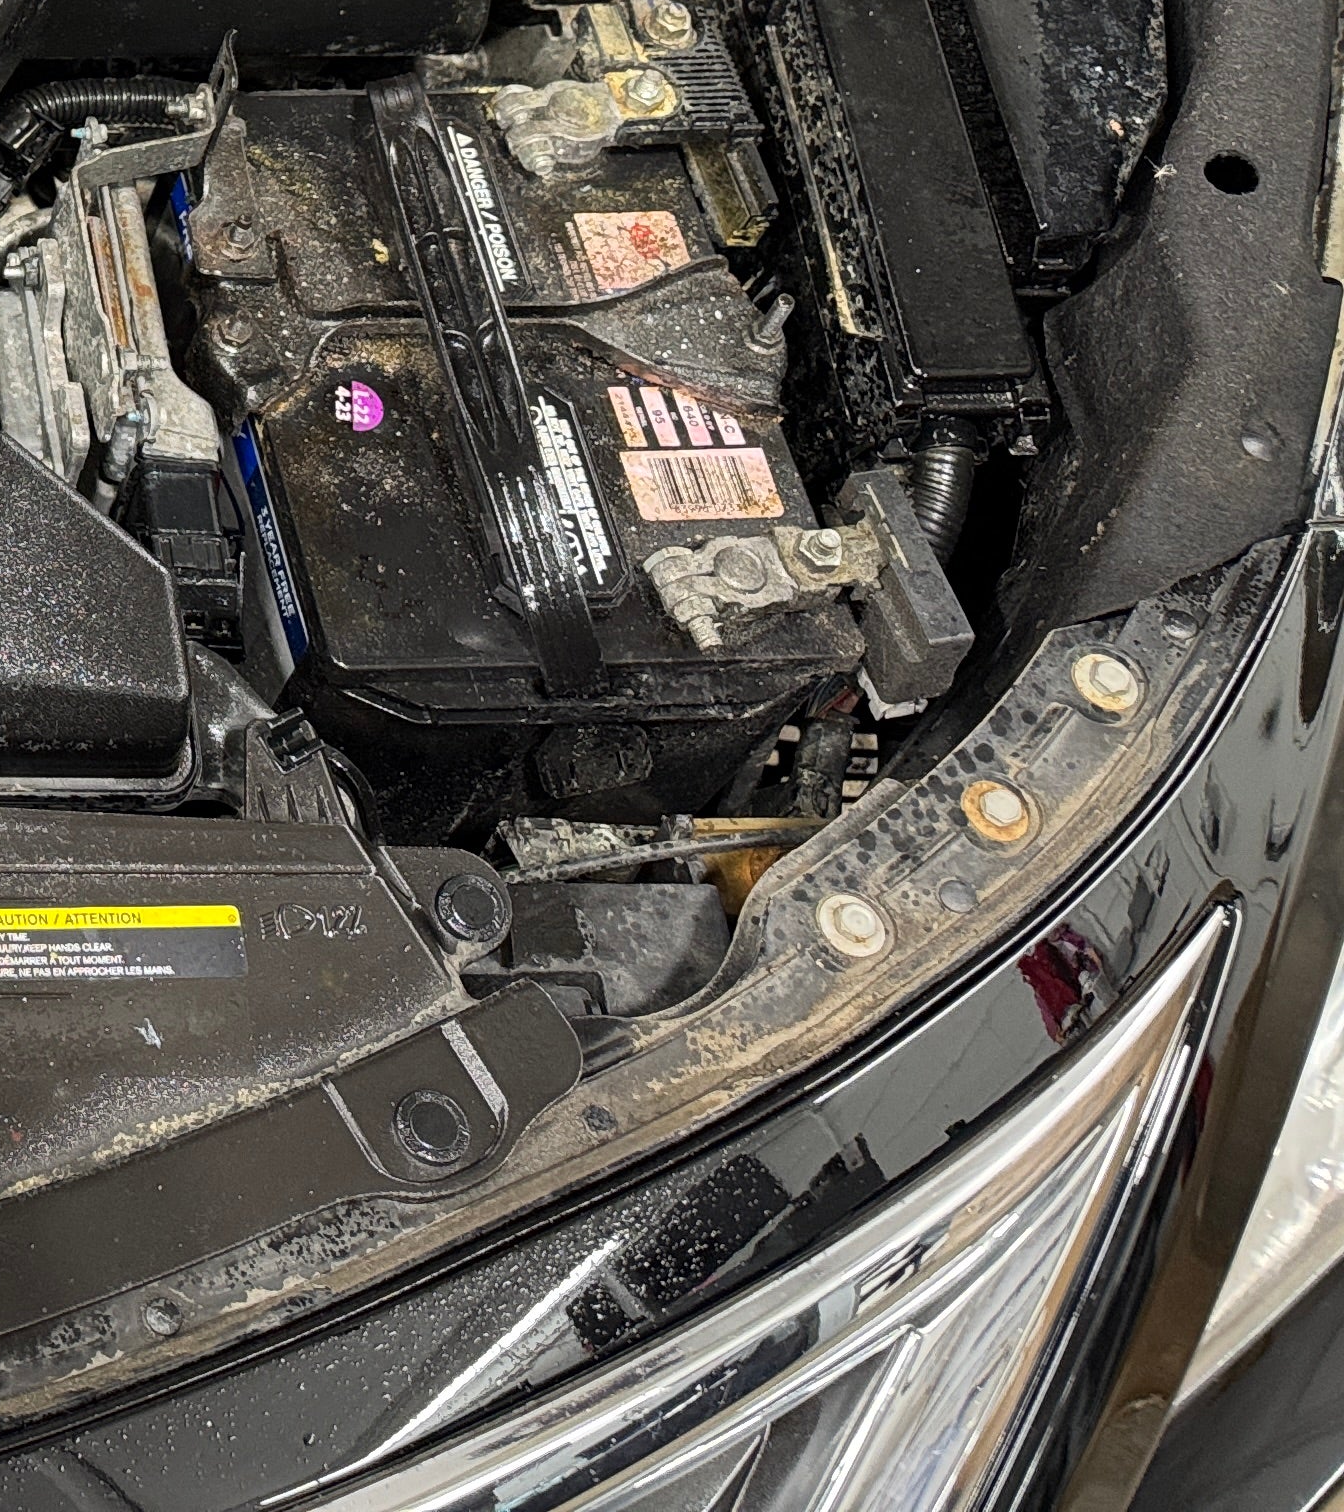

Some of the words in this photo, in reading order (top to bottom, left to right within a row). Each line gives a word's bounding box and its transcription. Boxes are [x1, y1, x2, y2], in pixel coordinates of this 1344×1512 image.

[462, 147, 496, 209] DANGER
[480, 210, 499, 222] /
[484, 223, 518, 281] POISON
[334, 385, 352, 423] 4-23
[352, 388, 370, 425] L-22
[651, 409, 666, 425] 95
[682, 404, 700, 428] 640
[257, 514, 289, 619] REPLACEMENT
[264, 515, 281, 569] YEAR
[277, 568, 296, 617] FREE
[54, 914, 59, 925] /
[65, 912, 141, 925] ATTENTION
[7, 932, 30, 941] TIME.
[48, 943, 80, 953] HANDS
[82, 943, 114, 952] CLEAR.
[58, 956, 81, 965] TOUT
[19, 969, 32, 977] NE
[33, 968, 52, 977] PAS
[53, 967, 65, 976] EN
[67, 967, 123, 976] APPROCHER
[125, 966, 142, 975] LES
